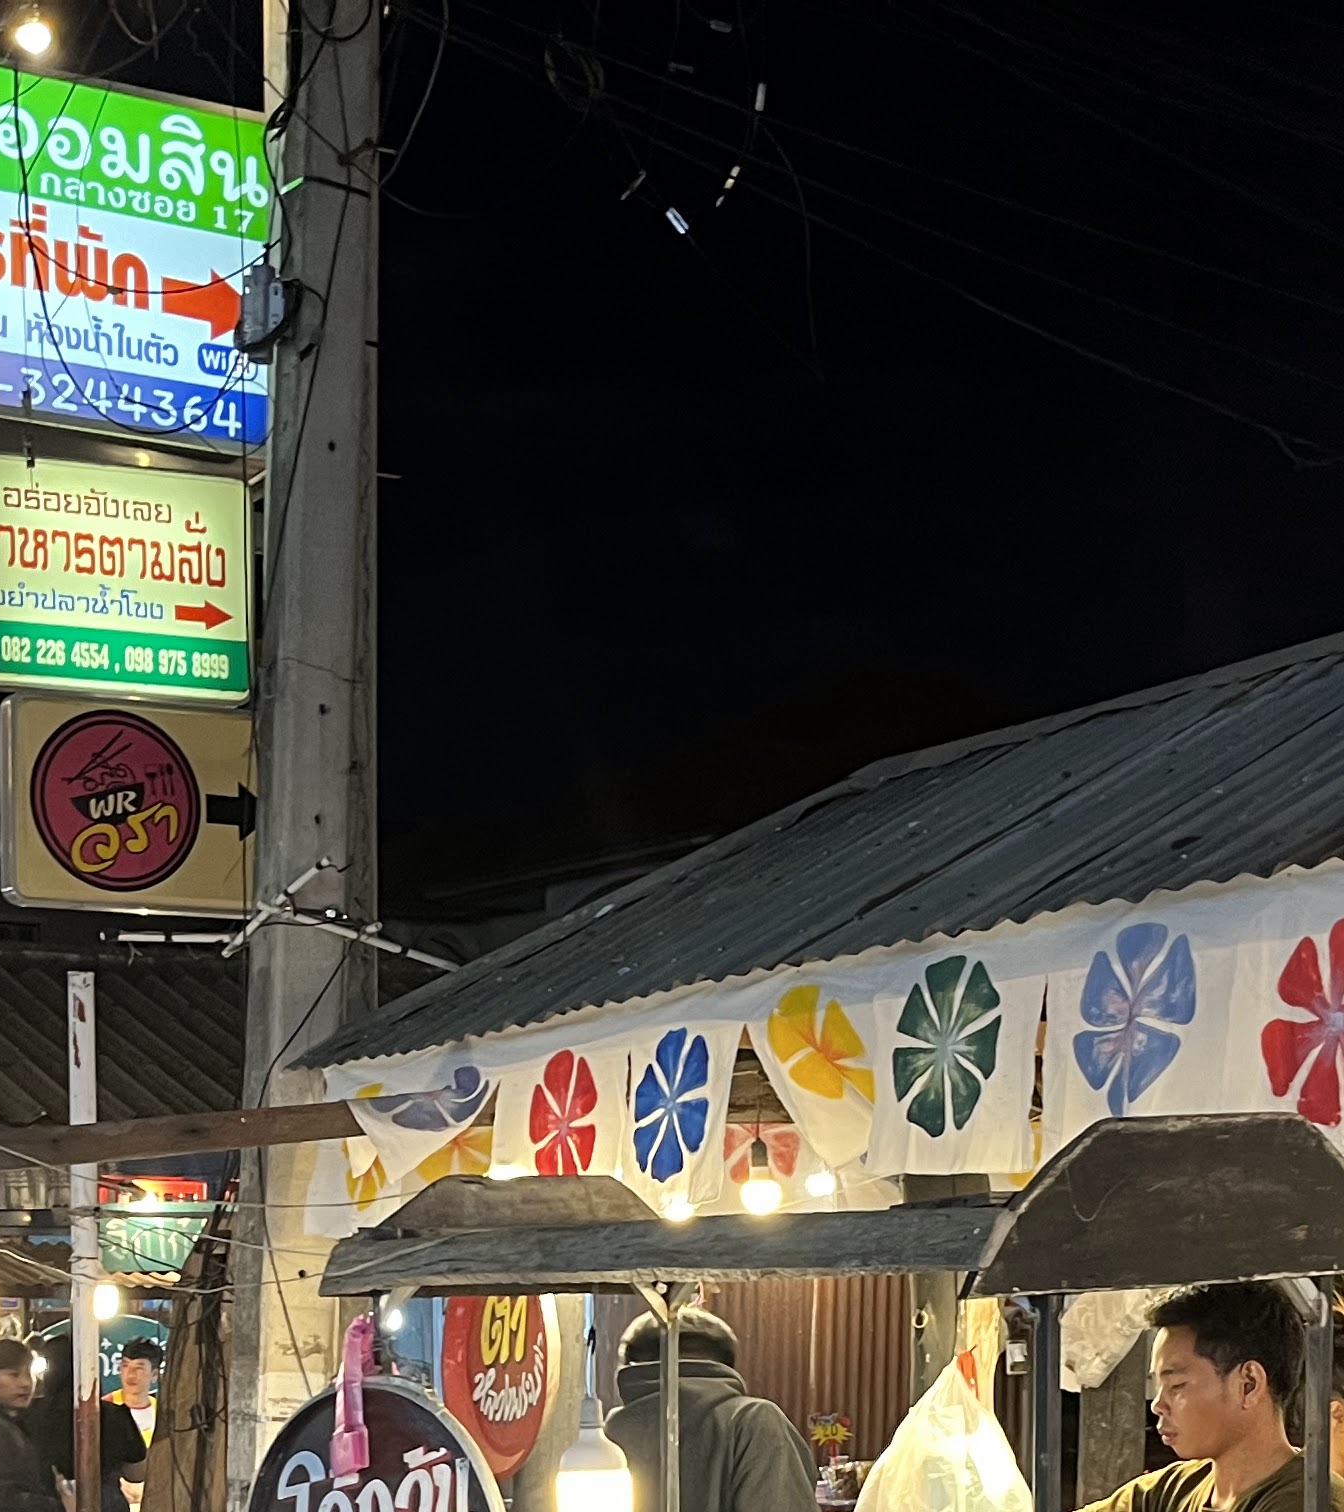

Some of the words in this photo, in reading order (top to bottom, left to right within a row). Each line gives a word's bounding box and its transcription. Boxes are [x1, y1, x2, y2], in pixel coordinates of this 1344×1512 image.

[40, 171, 196, 222] กลางซอย
[212, 204, 255, 235] 17
[25, 308, 179, 368] ห้องน้ำในตัว
[2, 482, 173, 525] อร่อยจังเลย
[0, 634, 32, 666] 082
[35, 637, 67, 667] 226
[70, 640, 110, 669] 4554
[124, 645, 154, 673] 098
[158, 648, 188, 676] 975
[191, 652, 230, 680] 8999
[88, 790, 138, 820] WR
